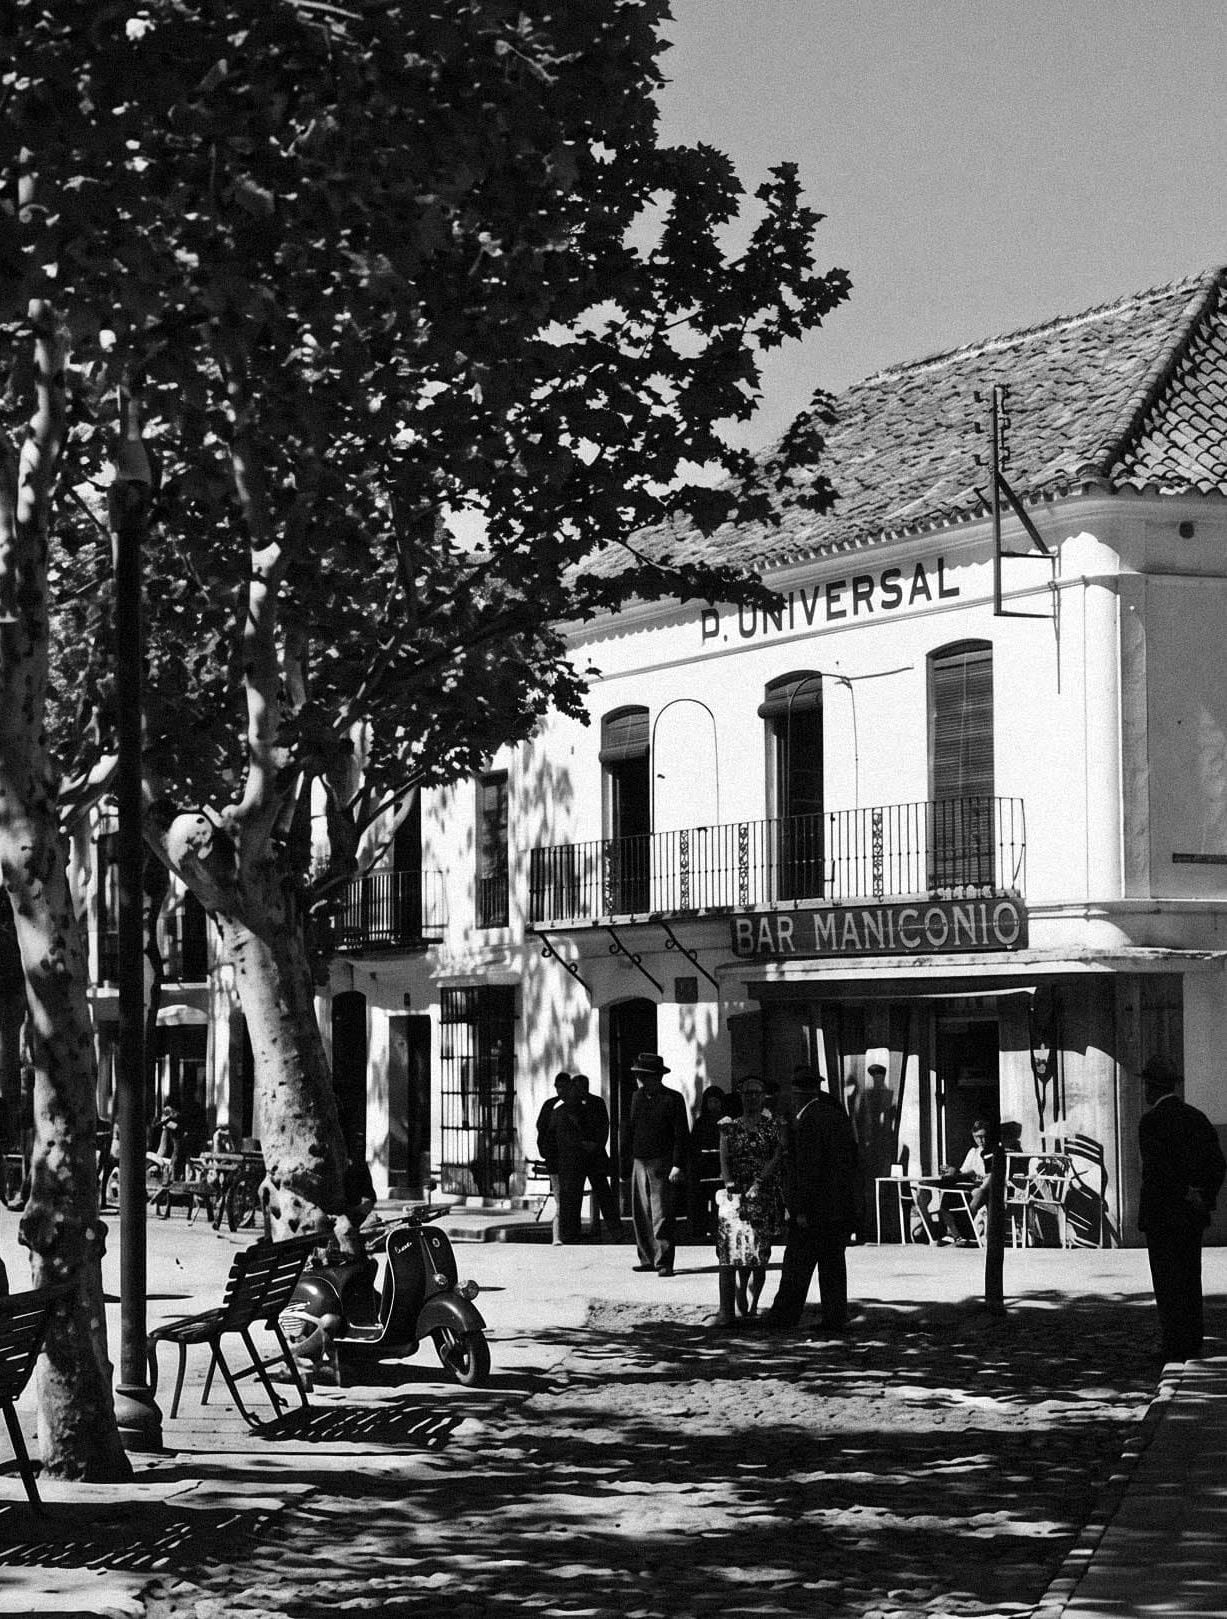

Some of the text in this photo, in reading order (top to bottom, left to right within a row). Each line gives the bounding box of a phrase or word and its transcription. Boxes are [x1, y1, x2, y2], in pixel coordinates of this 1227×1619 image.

[738, 556, 960, 639] UNIVERSAL
[735, 901, 1021, 953] BAR MANICONIO
